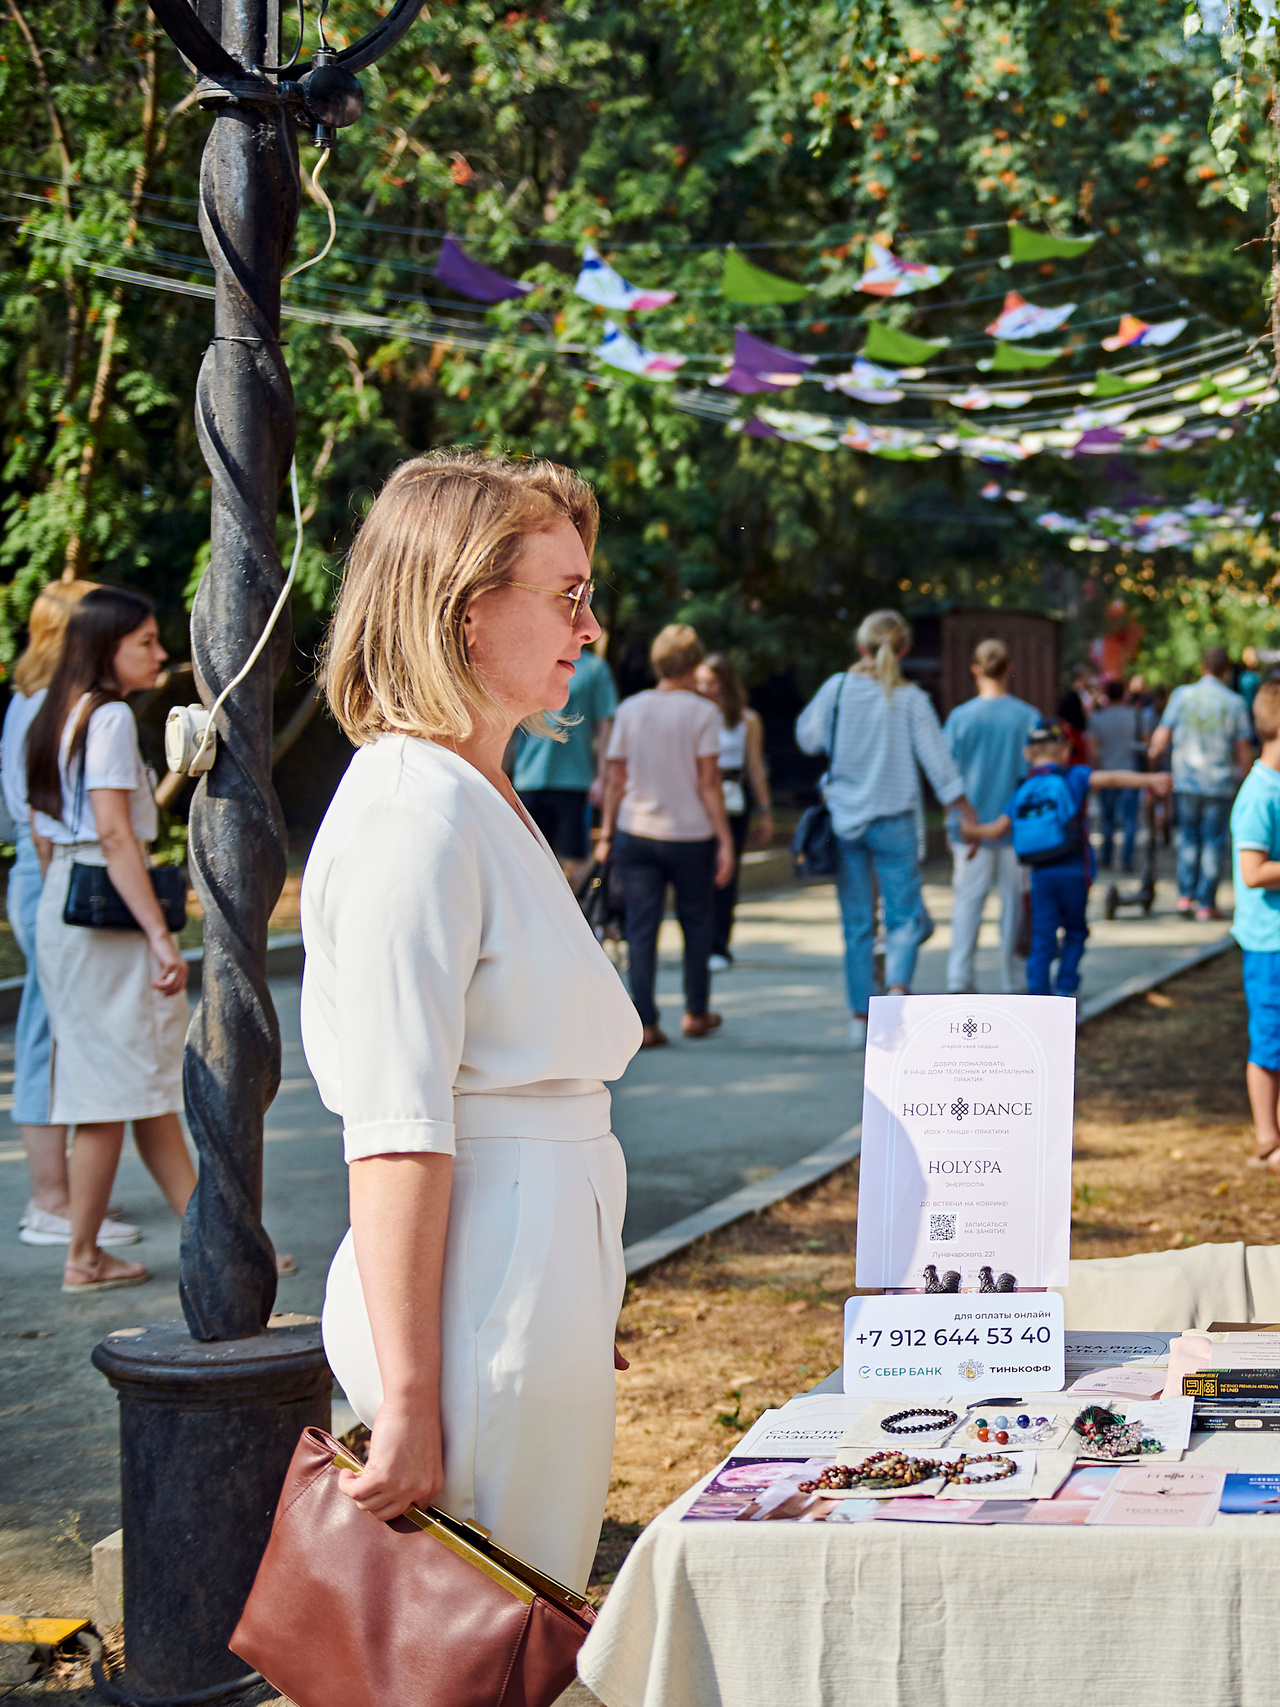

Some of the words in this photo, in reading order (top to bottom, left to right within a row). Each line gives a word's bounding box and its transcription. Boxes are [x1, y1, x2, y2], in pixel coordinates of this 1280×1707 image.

[950, 1022, 960, 1034] H
[981, 1022, 992, 1034] D
[933, 1060, 957, 1068] ДОБРО
[902, 1102, 948, 1117] HOLY
[972, 1102, 1033, 1116] DANCE
[920, 1200, 931, 1208] ДО
[931, 1251, 984, 1260] Луначарского,
[954, 1312, 973, 1321] для
[975, 1312, 1012, 1320] оплаты
[1014, 1310, 1051, 1319] онлайн
[856, 1330, 883, 1348] +7
[890, 1329, 927, 1347] 912
[934, 1328, 980, 1346] 644
[986, 1327, 1013, 1345] 53
[1020, 1326, 1051, 1344] 40
[875, 1367, 907, 1377] СБЕР
[909, 1366, 942, 1376] БАНК
[990, 1364, 1051, 1374] ТИНЬКОФФ
